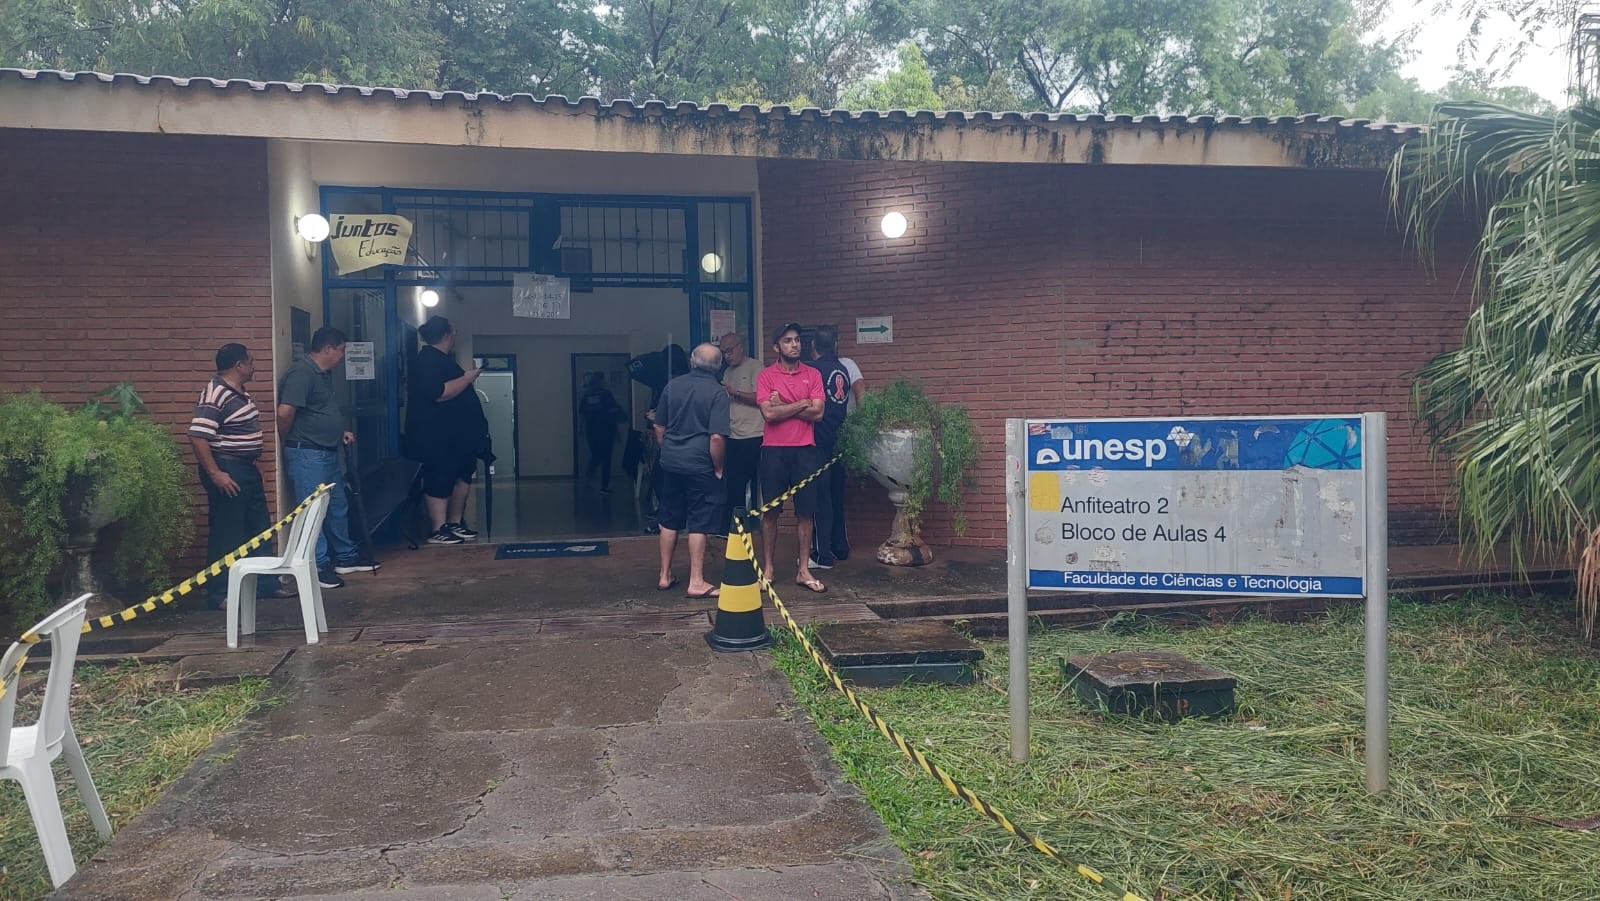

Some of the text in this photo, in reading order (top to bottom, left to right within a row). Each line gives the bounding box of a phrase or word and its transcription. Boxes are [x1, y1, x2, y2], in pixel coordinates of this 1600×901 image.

[358, 238, 402, 257] Educação
[1062, 438, 1167, 467] unesp
[1061, 496, 1169, 514] Anfiteatro 2
[1061, 523, 1227, 542] Bloco de Aulas 4
[1064, 572, 1322, 593] Faculdade de Ciências e Tecnologia
